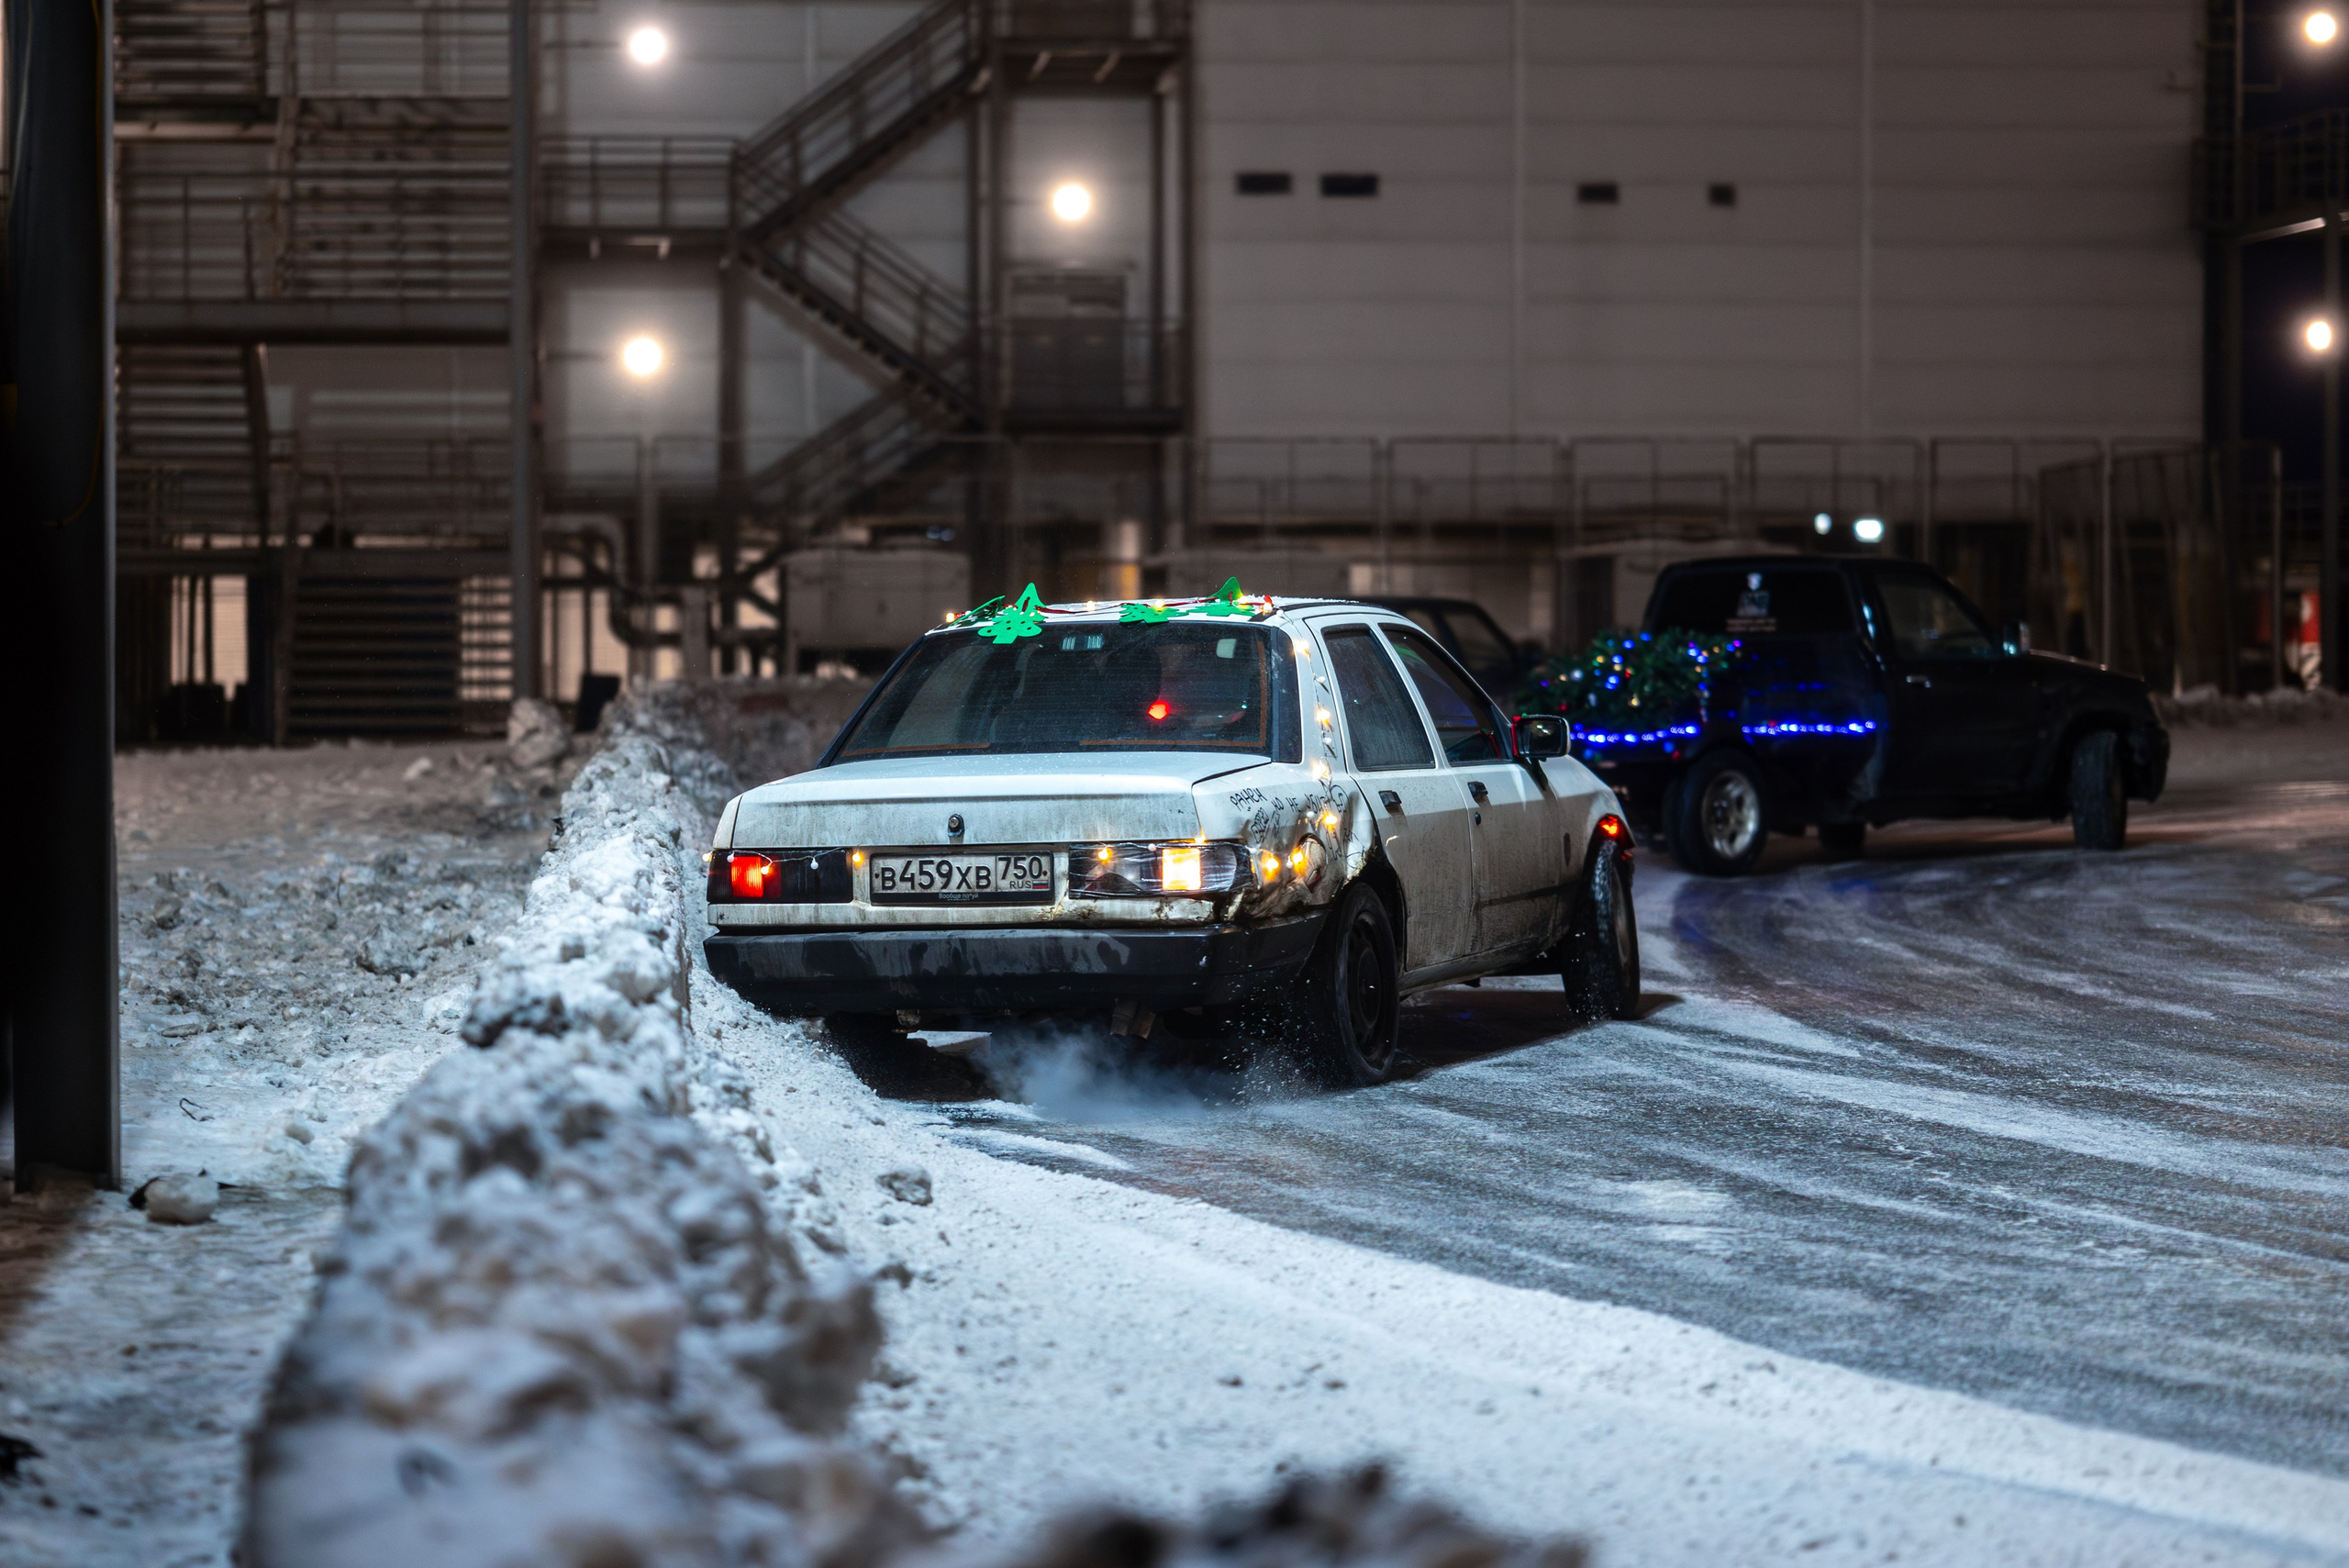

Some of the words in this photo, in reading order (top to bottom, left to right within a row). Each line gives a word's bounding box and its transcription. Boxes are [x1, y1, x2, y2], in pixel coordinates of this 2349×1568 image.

[1286, 796, 1301, 813] НЕ
[881, 859, 992, 891] В459ХВ
[997, 856, 1042, 880] 750
[1009, 880, 1032, 889] RUS
